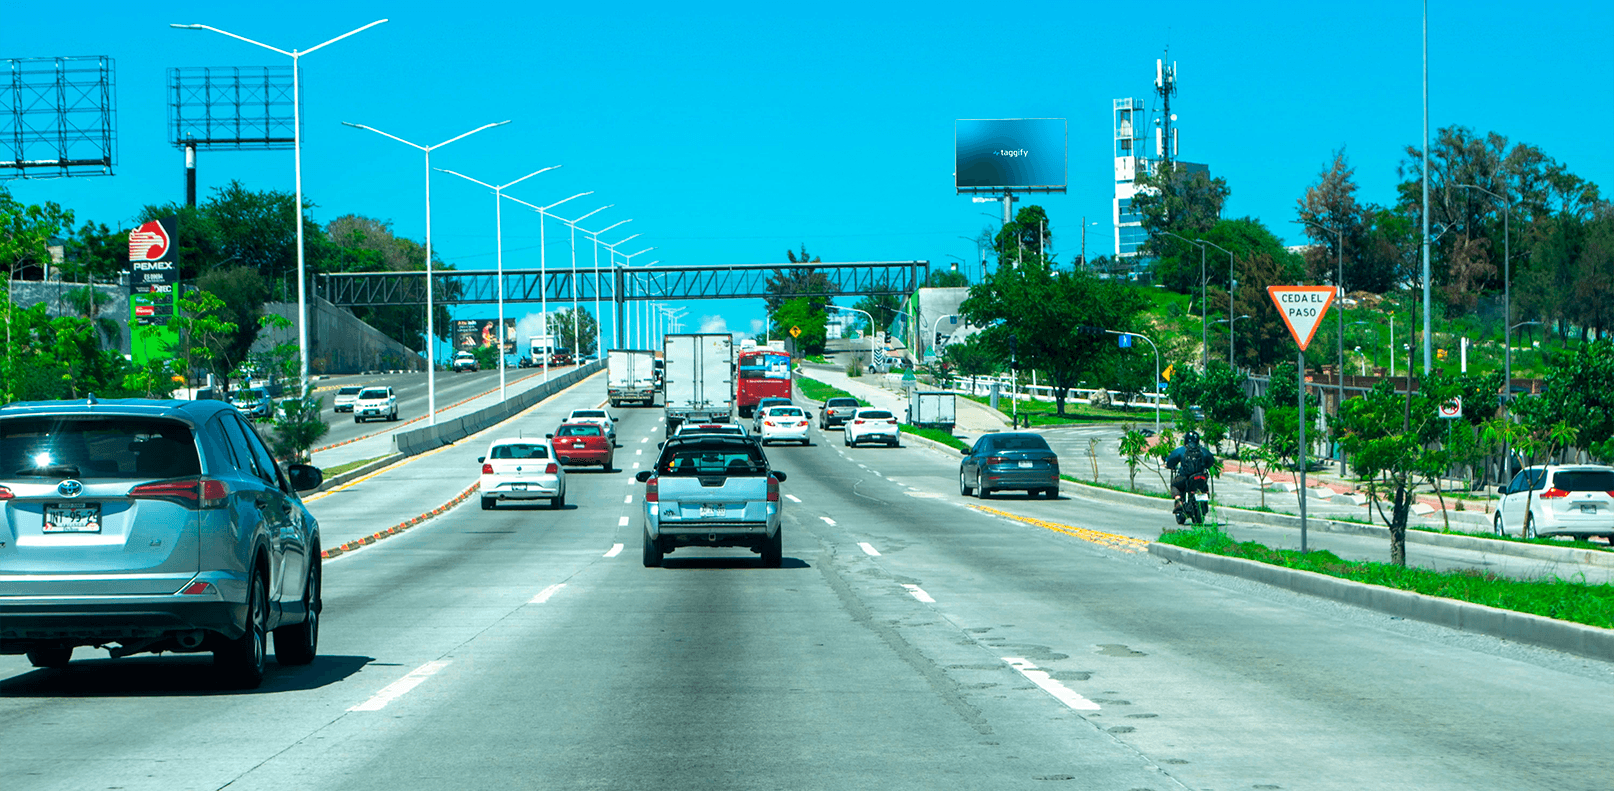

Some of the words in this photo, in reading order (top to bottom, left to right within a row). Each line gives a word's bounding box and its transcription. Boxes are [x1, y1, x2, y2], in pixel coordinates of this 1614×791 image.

[1000, 149, 1029, 158] taggify
[133, 262, 173, 271] PEMEX
[1281, 294, 1309, 303] CEDA
[1311, 294, 1323, 303] EL
[1289, 308, 1317, 317] PASO
